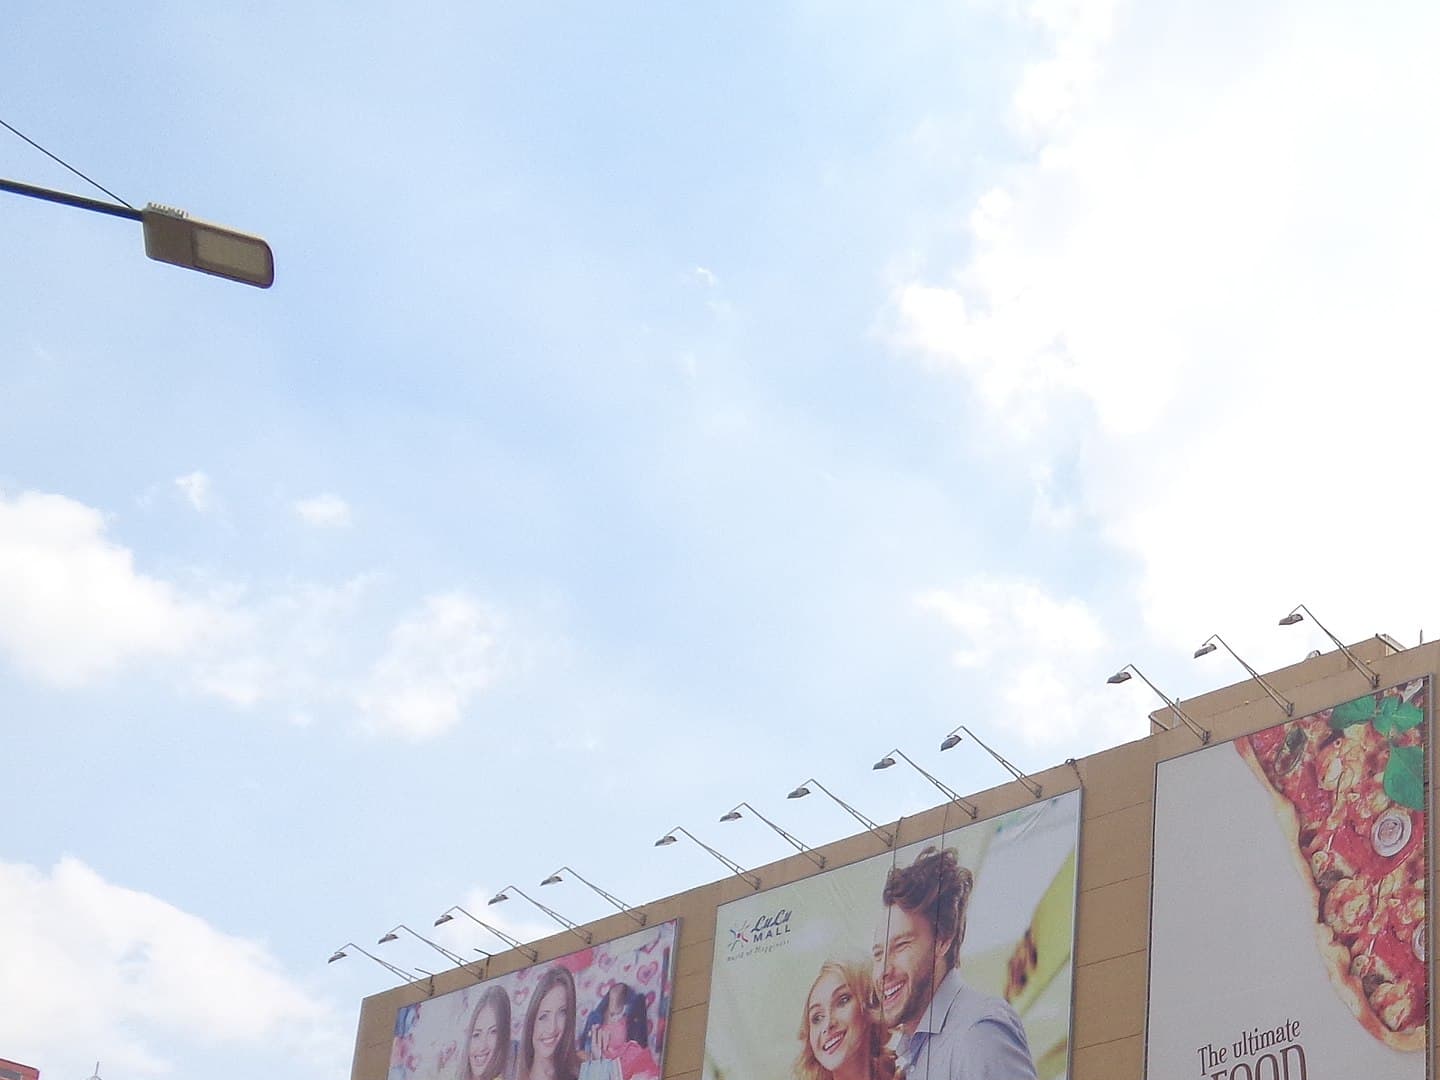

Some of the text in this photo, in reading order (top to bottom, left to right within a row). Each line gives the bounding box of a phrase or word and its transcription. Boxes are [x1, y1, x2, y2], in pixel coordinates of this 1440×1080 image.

[753, 925, 791, 943] MALL
[1197, 1018, 1300, 1076] The ultimate
